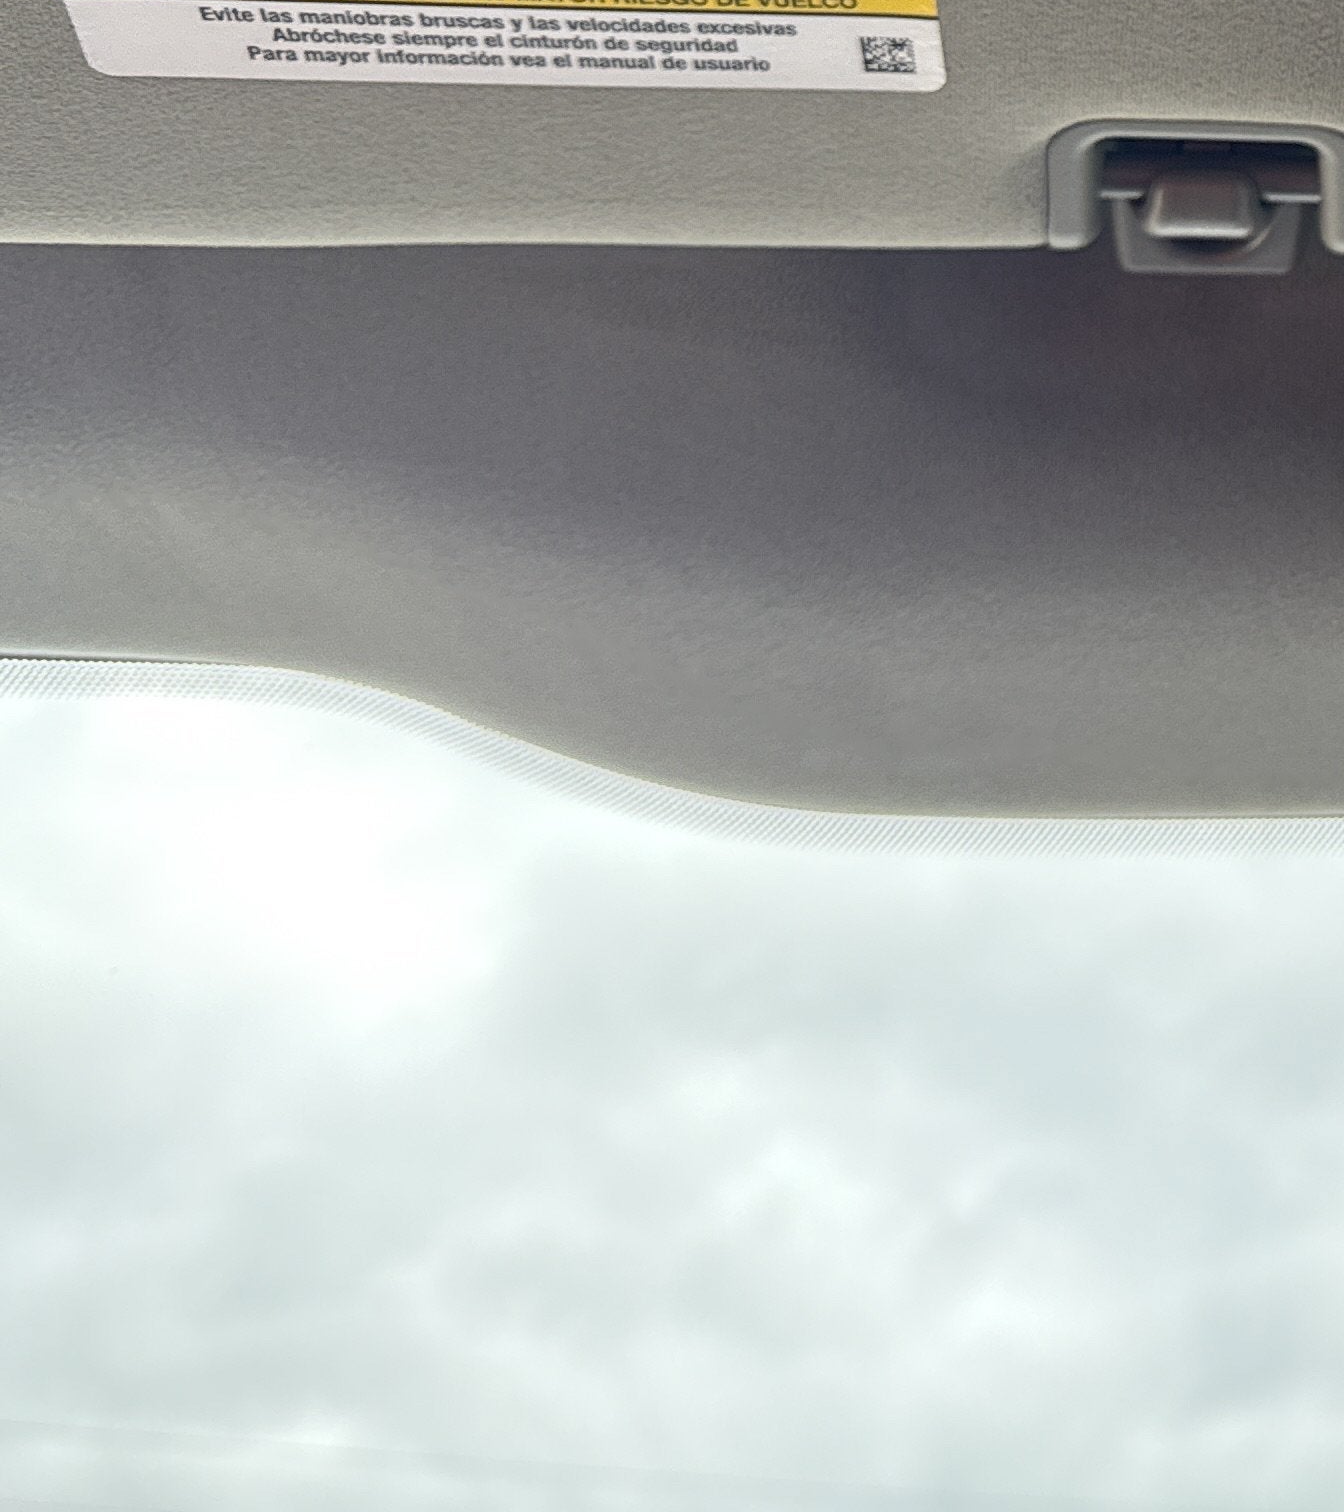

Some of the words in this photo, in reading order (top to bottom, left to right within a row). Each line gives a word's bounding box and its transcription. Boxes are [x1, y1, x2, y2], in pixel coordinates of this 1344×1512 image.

[199, 7, 254, 22] Evite
[260, 9, 293, 23] las
[300, 11, 414, 27] maniobras
[419, 13, 507, 31] bruscas
[512, 19, 523, 32] y
[529, 16, 560, 31] las
[566, 16, 691, 34] velocidades
[697, 21, 796, 36] excesivas
[272, 28, 386, 44] Abróchese
[393, 31, 478, 49] siempre
[485, 34, 505, 47] el
[509, 34, 597, 50] cinturón
[604, 36, 629, 50] de
[635, 37, 738, 55] seguridad
[248, 46, 298, 61] Para
[304, 50, 370, 66] mayor
[510, 55, 547, 67] vea
[553, 54, 572, 68] el
[579, 55, 654, 70] manual
[661, 56, 687, 70] de
[694, 57, 770, 72] usuario
